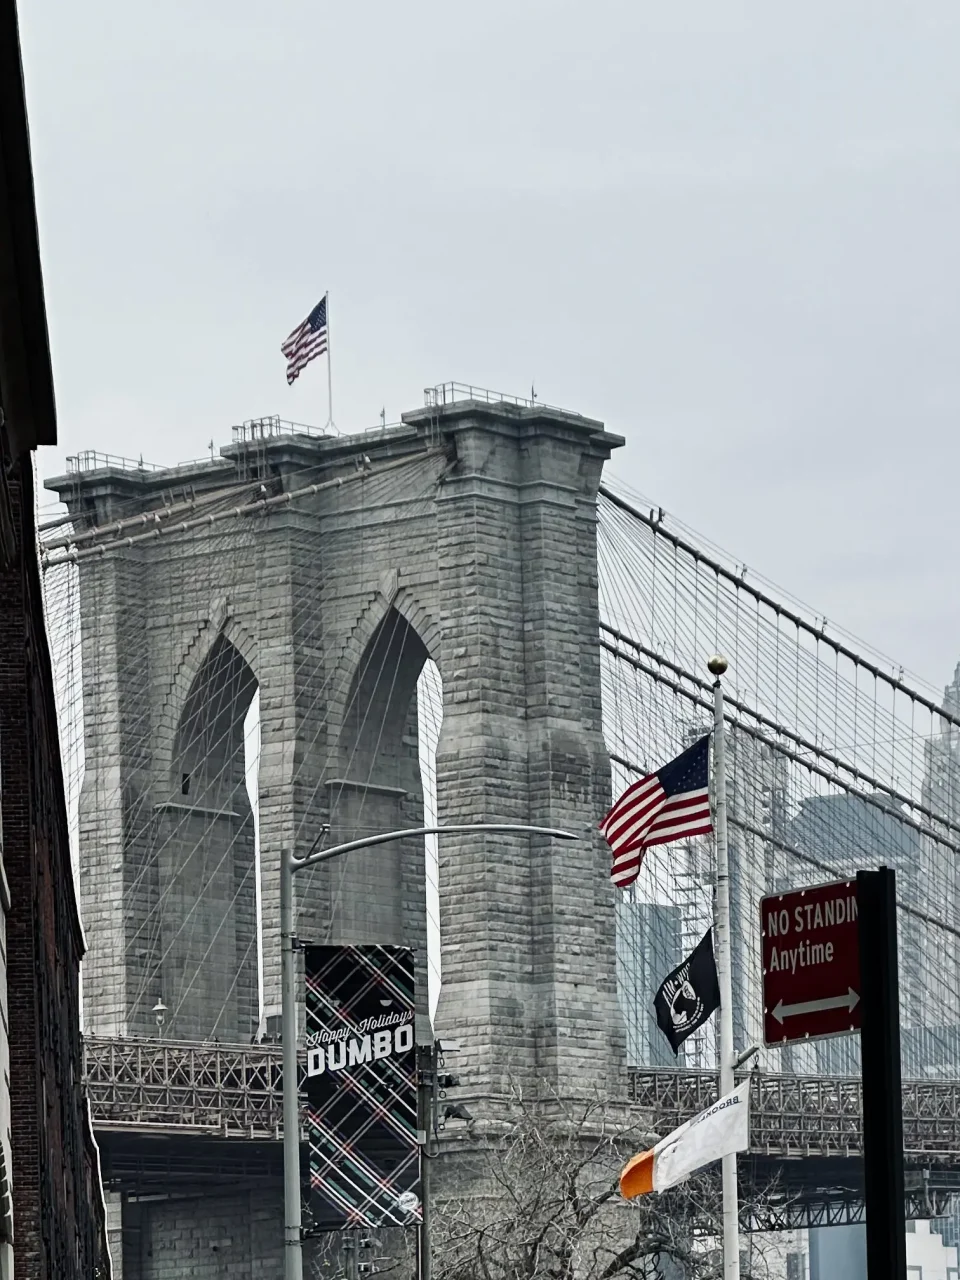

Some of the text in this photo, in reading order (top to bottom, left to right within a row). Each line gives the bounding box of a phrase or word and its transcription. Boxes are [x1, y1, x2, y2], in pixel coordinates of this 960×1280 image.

[768, 896, 858, 937] NO STANDIN
[769, 939, 834, 975] Anytime
[306, 1010, 413, 1047] Happy Holidays
[307, 1024, 413, 1077] DUMBO
